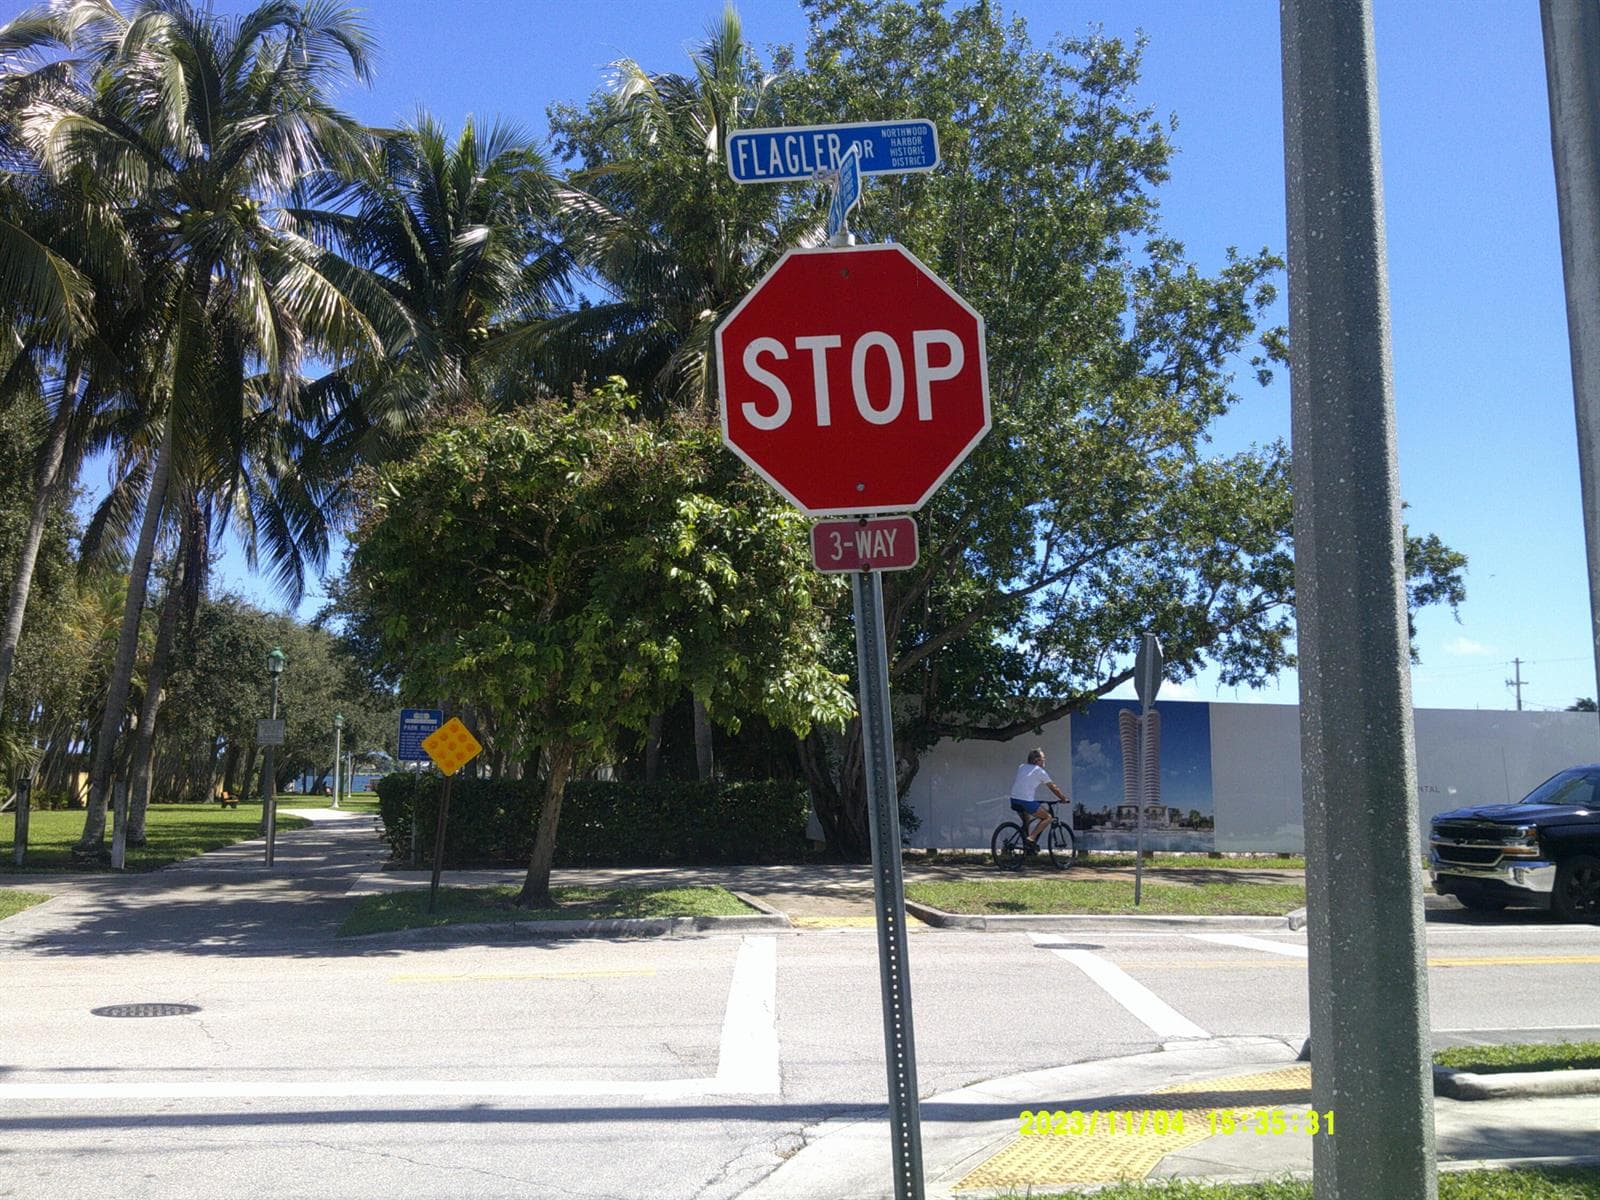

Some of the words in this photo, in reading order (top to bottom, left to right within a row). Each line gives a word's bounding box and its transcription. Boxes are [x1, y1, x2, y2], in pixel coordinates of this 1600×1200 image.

[881, 126, 928, 138] NORTHWOOD
[890, 136, 922, 147] HARBOR
[737, 133, 842, 177] FLAGLER
[853, 139, 875, 159] DR
[890, 146, 925, 157] HISTORIC
[891, 155, 926, 167] DISTRICT
[741, 329, 965, 430] STOP
[829, 528, 897, 561] 3-WAY
